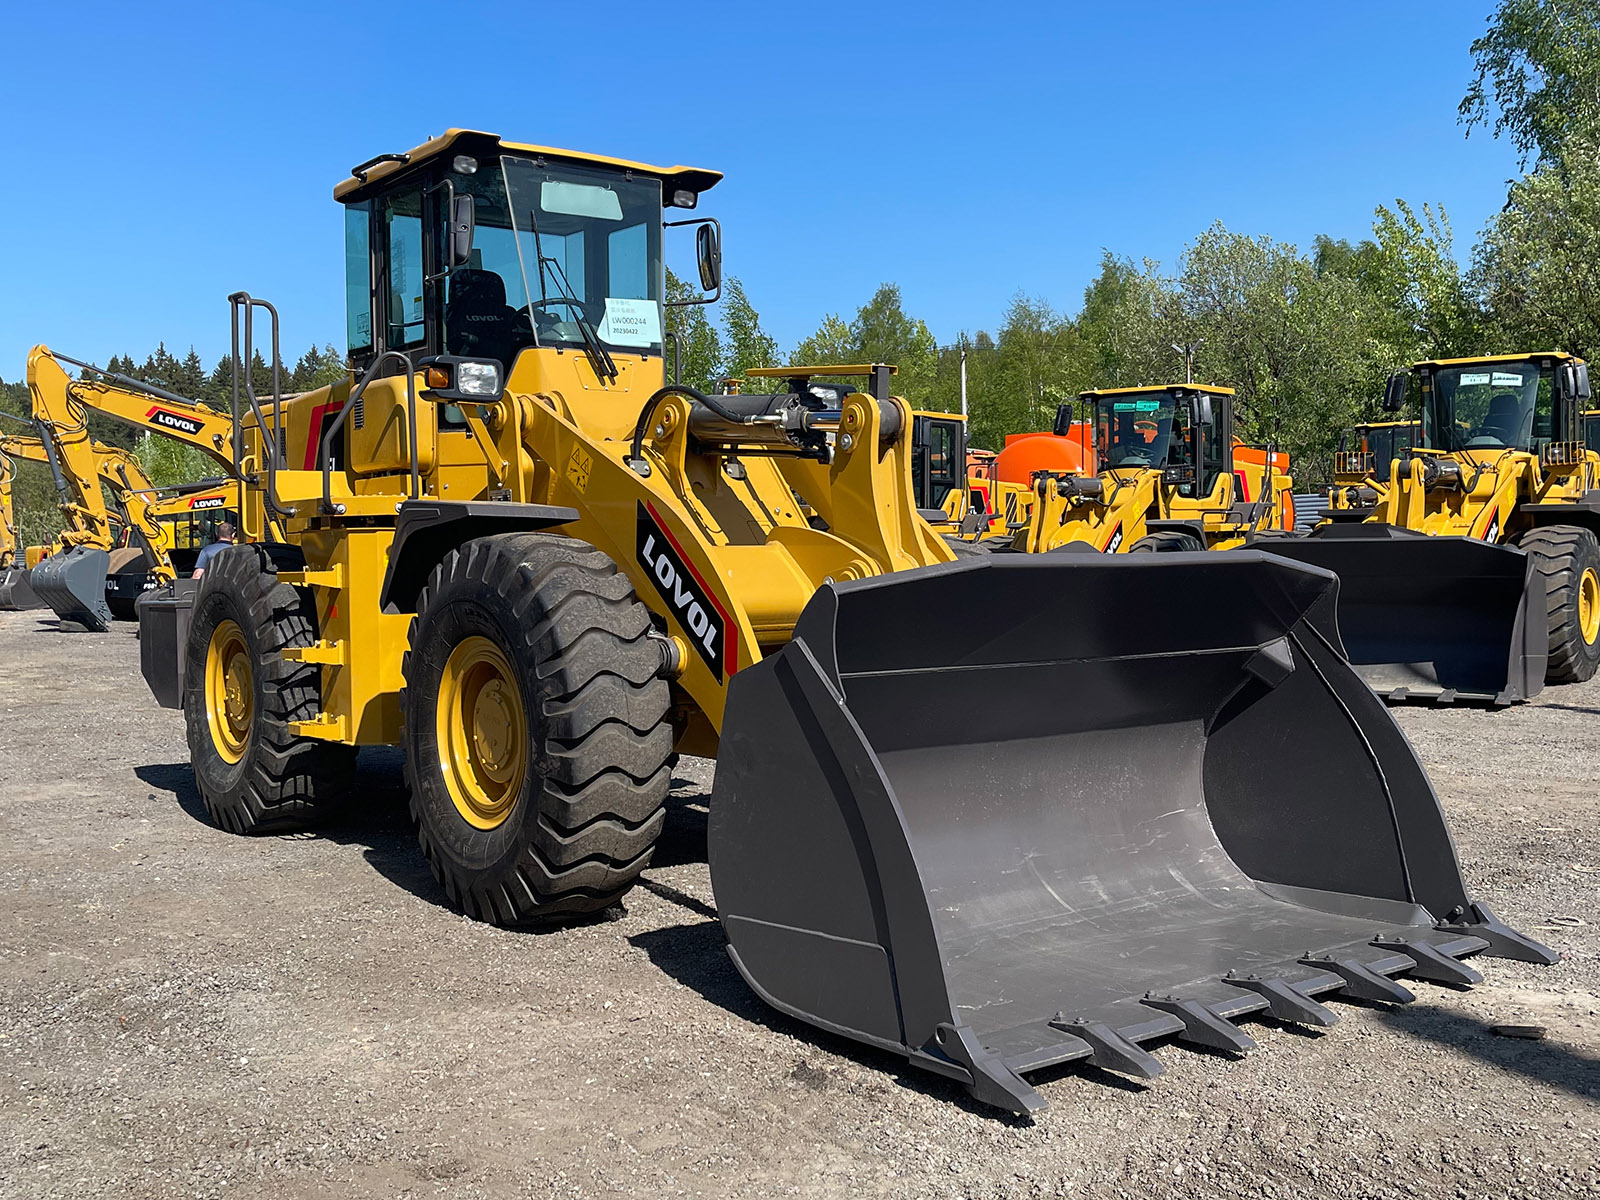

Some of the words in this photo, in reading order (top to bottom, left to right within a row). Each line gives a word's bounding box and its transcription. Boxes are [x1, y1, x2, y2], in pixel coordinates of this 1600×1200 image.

[465, 314, 501, 322] LOVOL
[611, 316, 647, 325] LW000244
[158, 414, 197, 432] LOVOL
[194, 499, 224, 508] LOVOL
[1106, 532, 1122, 554] VOL
[642, 534, 717, 659] LOVOL
